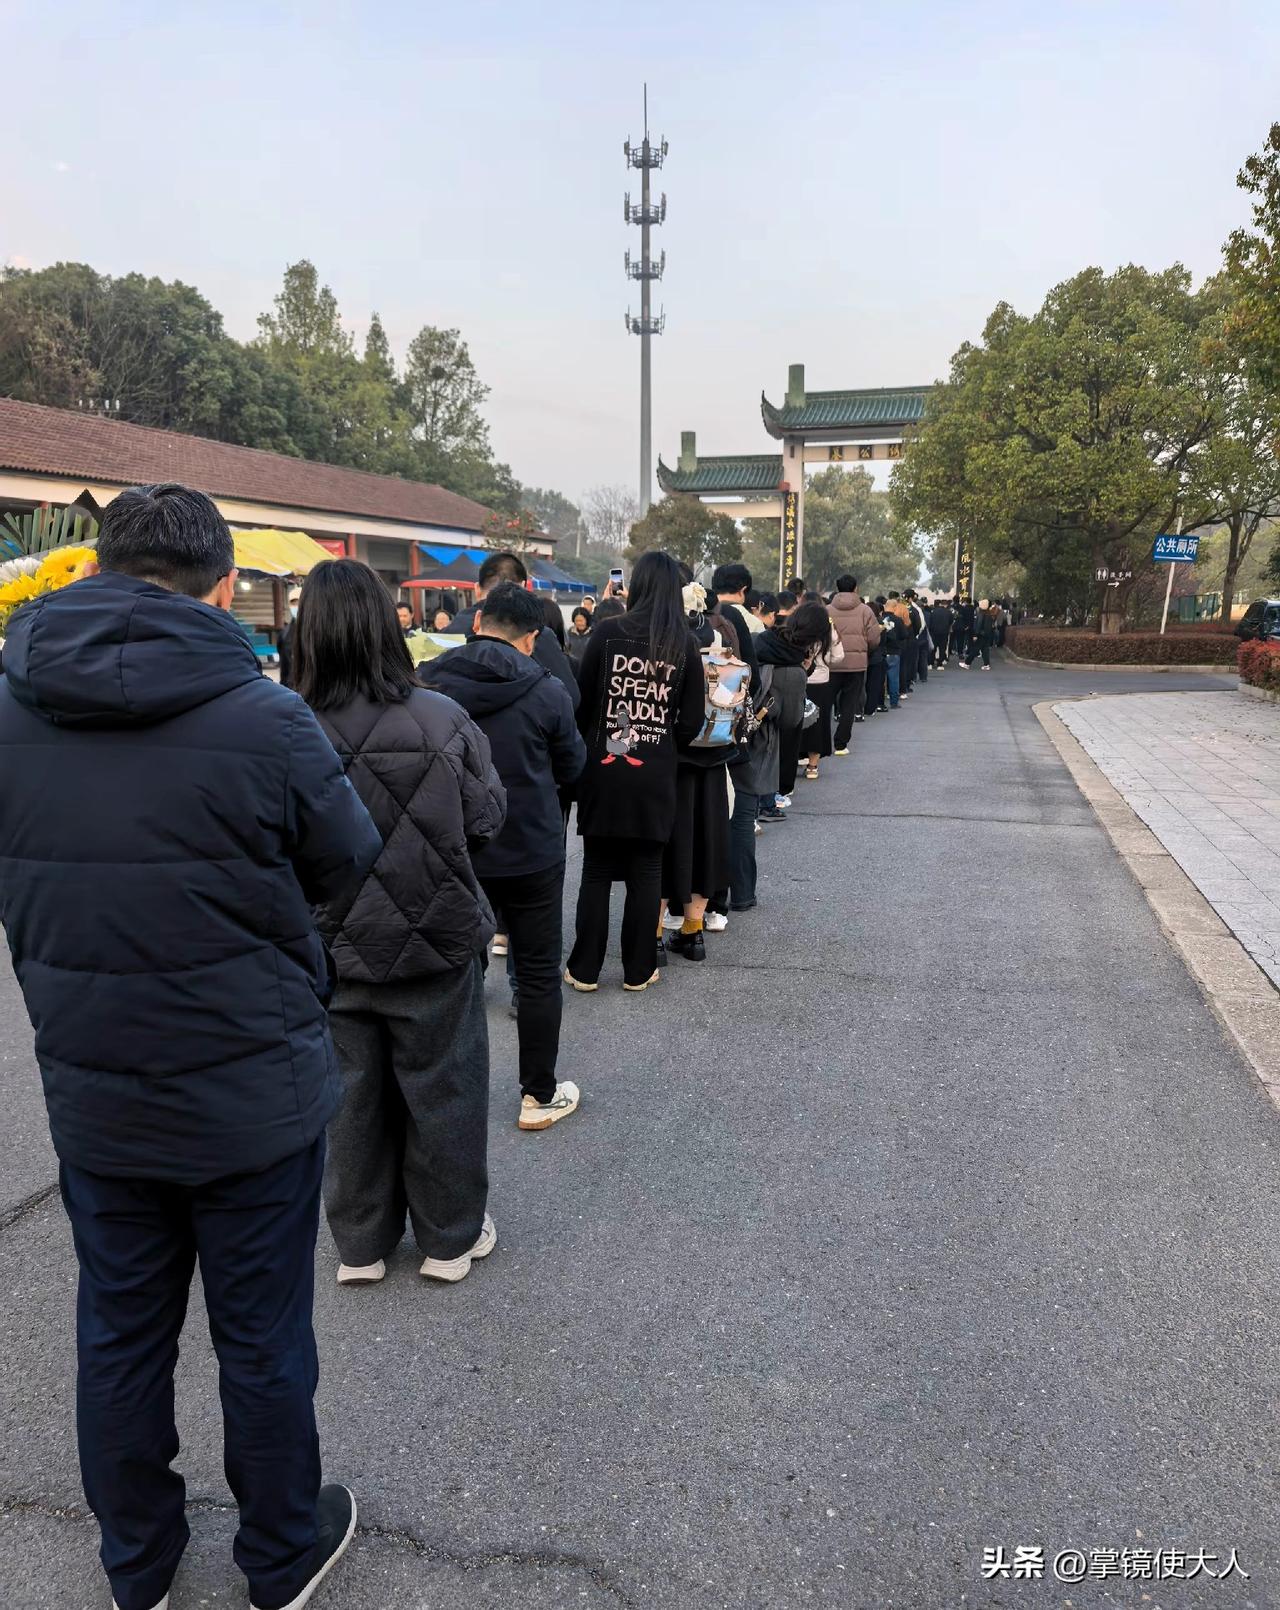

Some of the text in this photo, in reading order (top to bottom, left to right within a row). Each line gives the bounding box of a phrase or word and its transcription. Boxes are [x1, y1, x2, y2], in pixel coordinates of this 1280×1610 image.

[1156, 537, 1198, 555] 公共厕所
[612, 654, 676, 681] DON'T
[608, 675, 672, 703] SPEAK
[606, 698, 669, 724] LOUDLY
